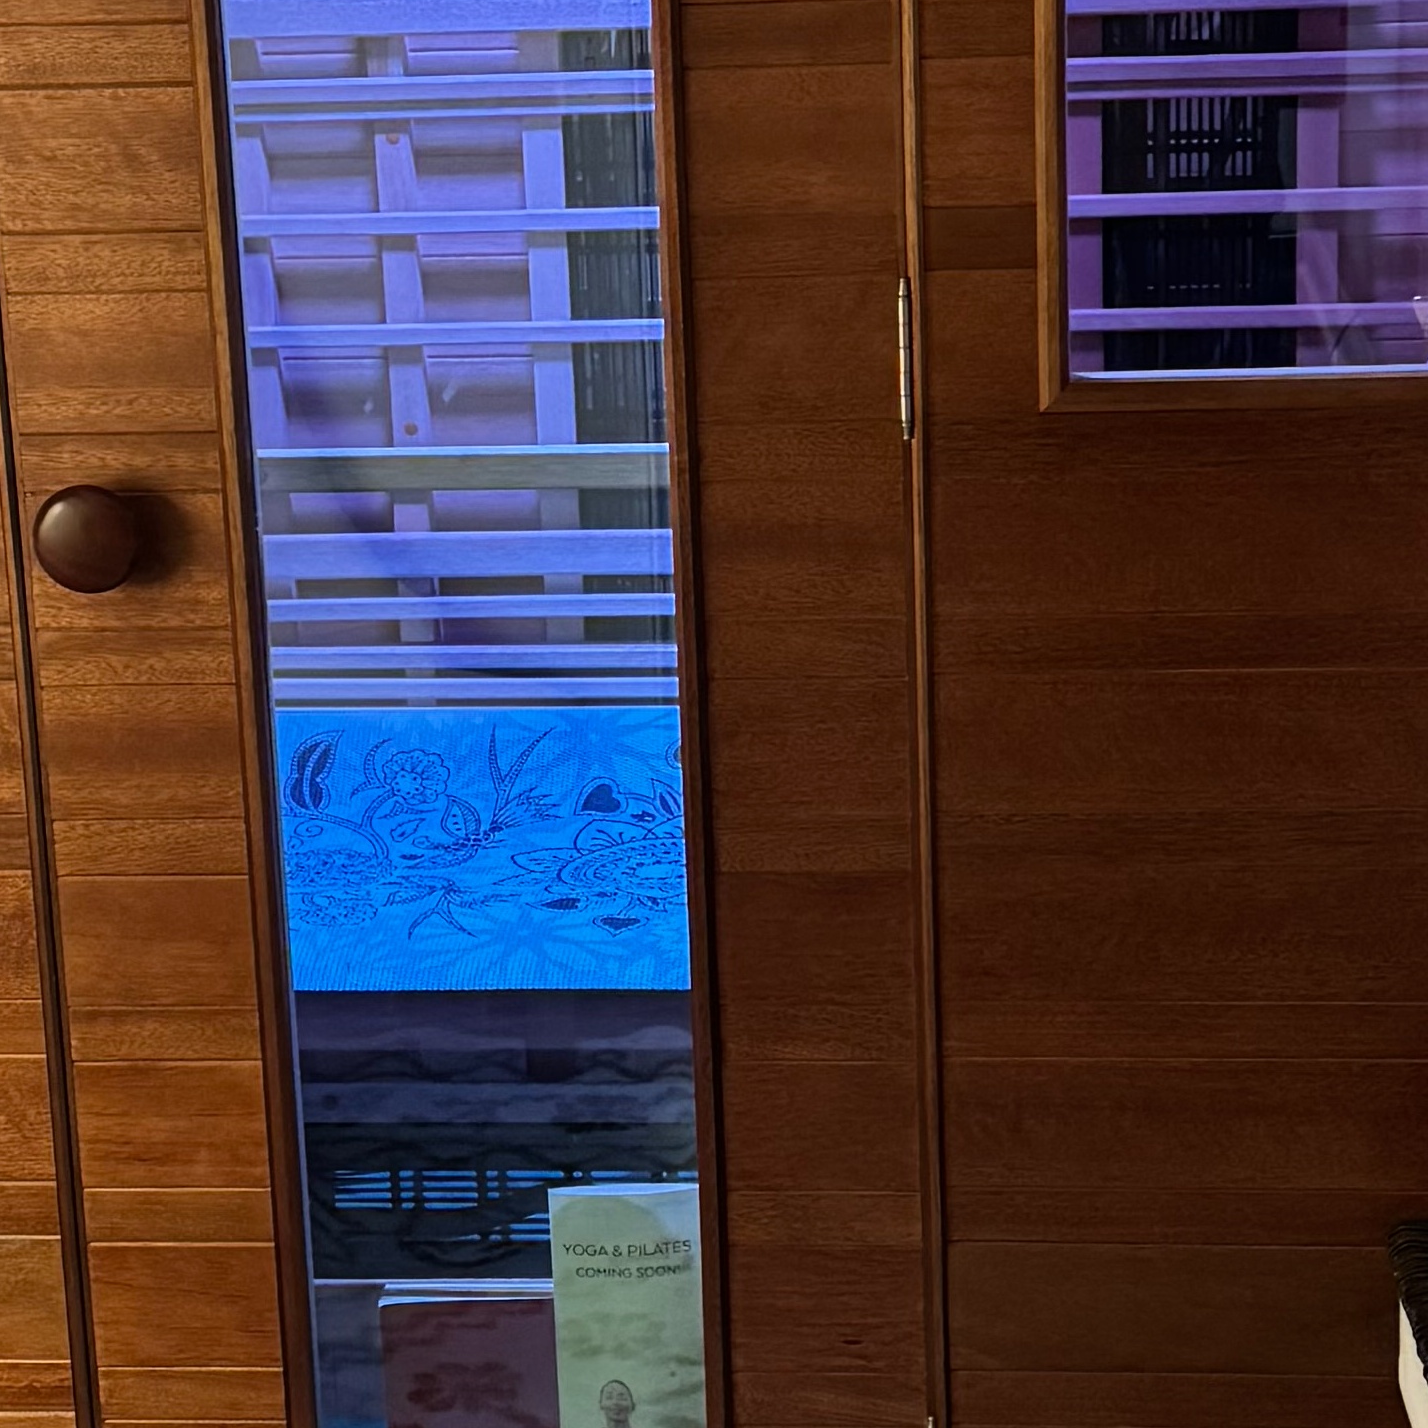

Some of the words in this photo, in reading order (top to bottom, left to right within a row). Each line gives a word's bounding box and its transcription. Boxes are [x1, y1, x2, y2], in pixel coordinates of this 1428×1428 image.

[562, 1243, 609, 1257] YOGA
[612, 1244, 623, 1257] &
[627, 1239, 692, 1258] PILATES
[575, 1266, 633, 1280] COMING
